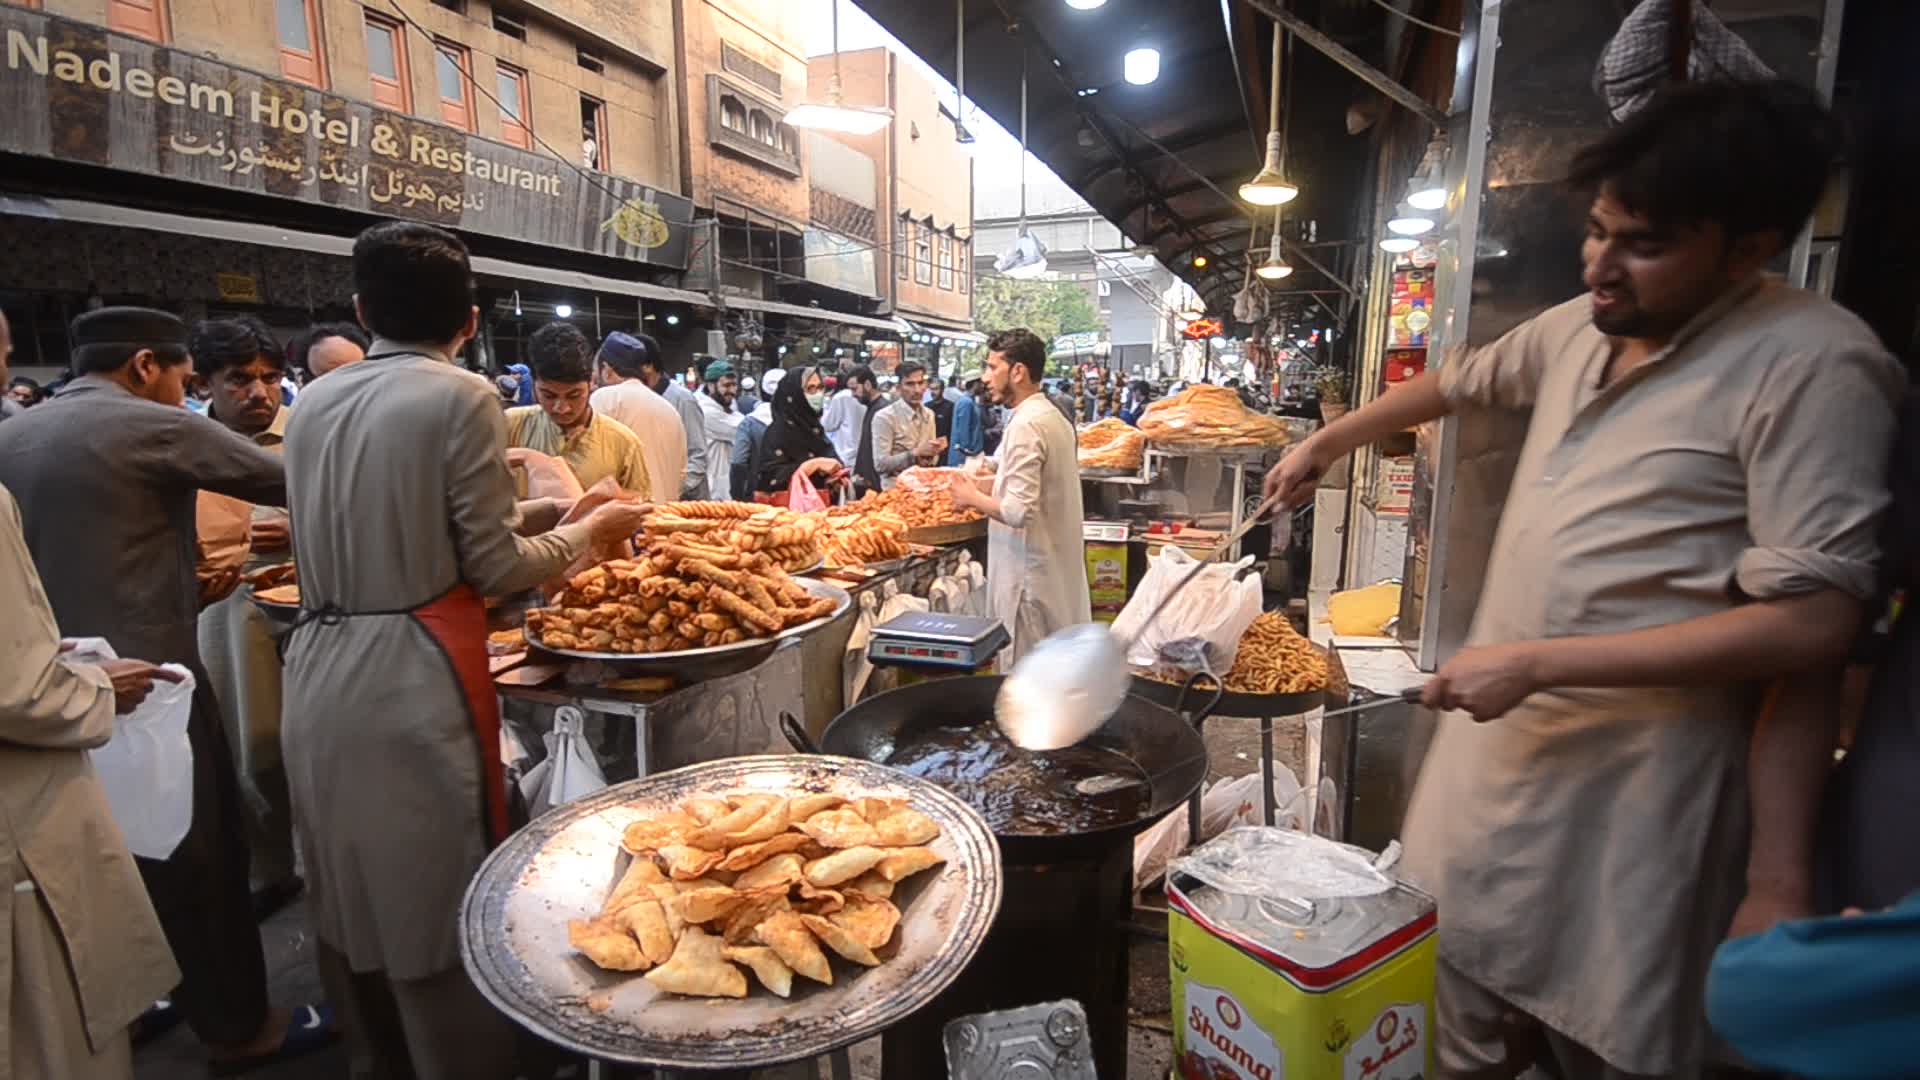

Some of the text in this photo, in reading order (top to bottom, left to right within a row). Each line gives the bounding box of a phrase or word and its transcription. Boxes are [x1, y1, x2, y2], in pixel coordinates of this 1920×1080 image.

[7, 29, 561, 197] Nadeem Hotel & Restaurant
[1189, 1005, 1273, 1080] Shama
